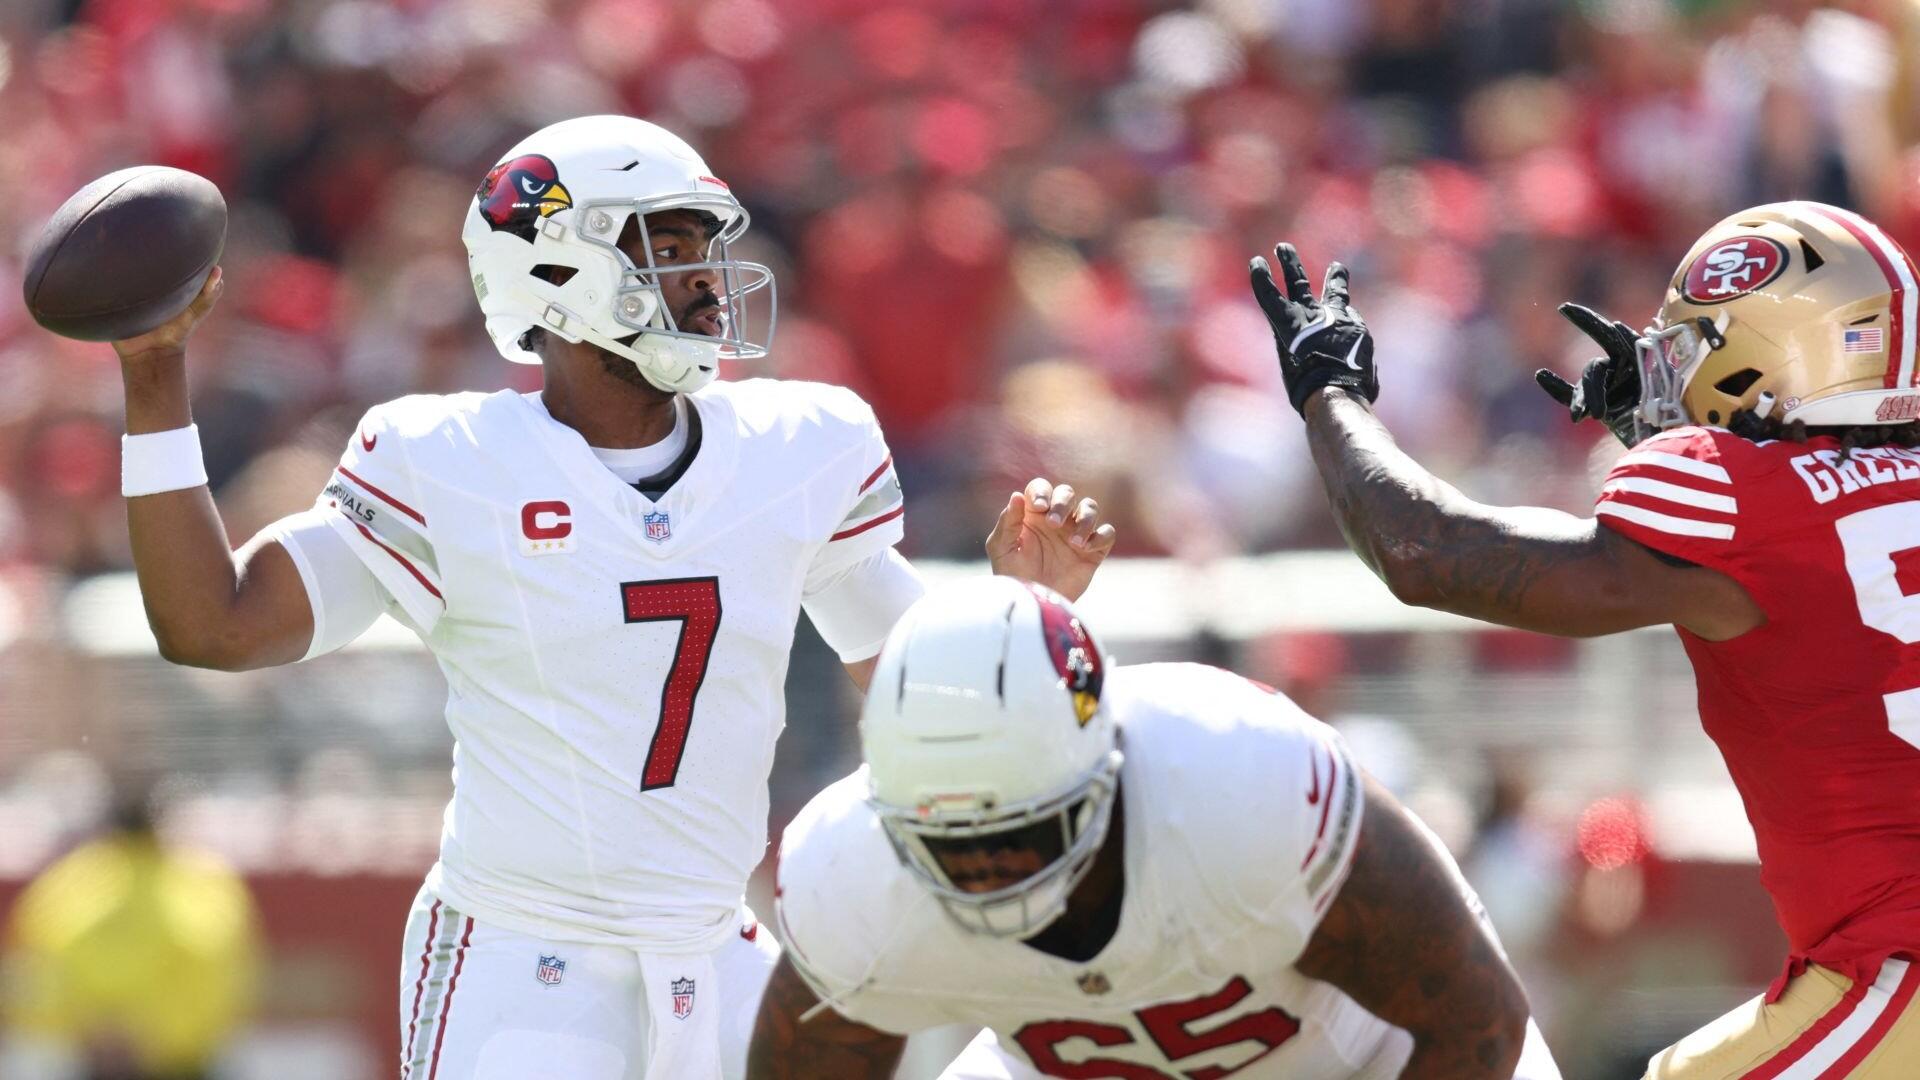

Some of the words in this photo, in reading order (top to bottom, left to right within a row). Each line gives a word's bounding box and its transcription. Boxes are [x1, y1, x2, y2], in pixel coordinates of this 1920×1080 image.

[1790, 446, 1920, 505] GREE
[521, 500, 572, 541] C
[648, 524, 669, 539] NFL
[620, 576, 722, 792] 7
[539, 966, 560, 982] NFL
[673, 995, 692, 1015] NFL
